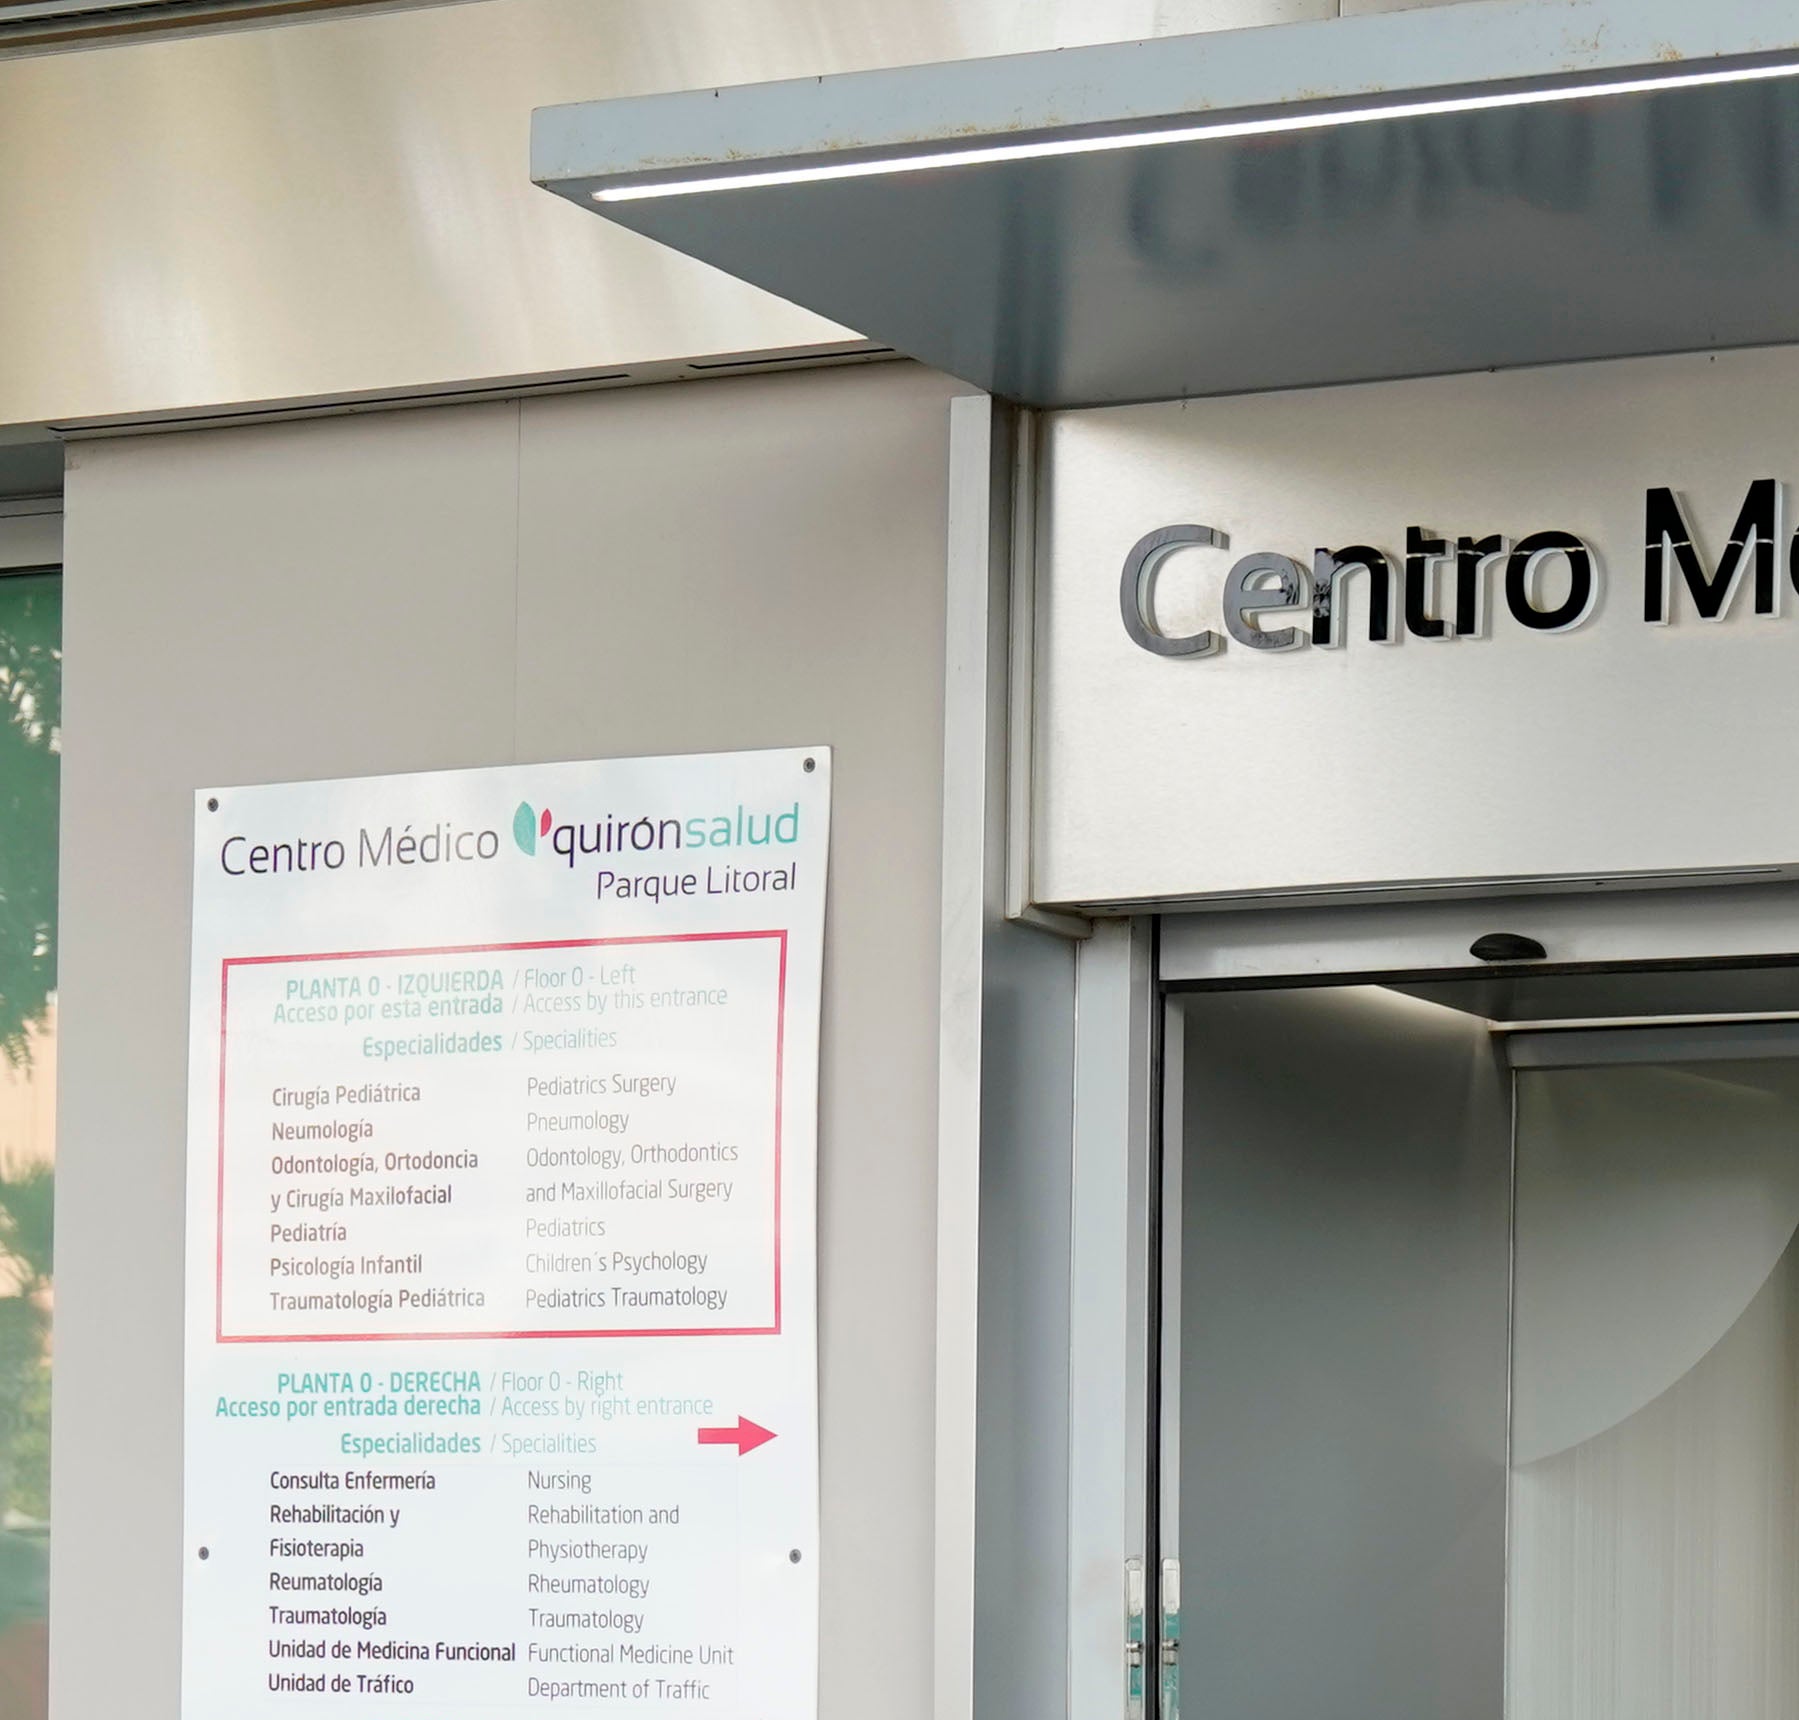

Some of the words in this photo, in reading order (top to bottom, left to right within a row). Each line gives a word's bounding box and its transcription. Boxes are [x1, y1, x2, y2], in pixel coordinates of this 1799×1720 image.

[1119, 522, 1605, 659] Centro
[222, 837, 344, 875] Centro
[360, 823, 498, 867] Médico
[553, 803, 798, 867] quirónsalud
[598, 871, 696, 904] Parque
[707, 862, 796, 894] Litoral
[287, 976, 361, 1000] PLANTA
[368, 976, 380, 996] 0
[398, 969, 504, 998] IZQUIERDA
[525, 968, 566, 988] Floor
[572, 966, 583, 987] 0
[601, 963, 636, 985] Left
[273, 1003, 338, 1024] Acceso
[344, 1004, 375, 1026] por
[381, 999, 421, 1019] esta
[428, 992, 503, 1016] entrada
[363, 1031, 502, 1062] Especialidades
[524, 1028, 616, 1054] Specialities
[273, 1086, 329, 1110] Cirugía
[336, 1083, 420, 1104] Pediátrica
[528, 1075, 606, 1096] Pediatrics
[612, 1074, 676, 1097] Surgery
[273, 1119, 373, 1143] Neumología
[528, 1110, 629, 1134] Pneumology
[272, 1152, 378, 1177] Odontología,
[385, 1149, 478, 1171] Ortodoncia
[527, 1146, 624, 1169] Odontology,
[631, 1142, 738, 1163] Orthodontics
[271, 1194, 281, 1213] y
[287, 1188, 343, 1212] Cirugía
[351, 1184, 451, 1206] Maxilofacial
[526, 1182, 556, 1202] and
[562, 1179, 662, 1200] Maxillofacial
[668, 1179, 733, 1202] Surgery
[271, 1222, 346, 1242] Pediatría
[271, 1256, 354, 1280] Psicología
[361, 1254, 422, 1274] Infantil
[613, 1251, 707, 1275] Psychology
[270, 1289, 392, 1313] Traumatología
[399, 1288, 484, 1308] Pediátrica
[527, 1288, 605, 1308] Pediatrics
[611, 1286, 727, 1310] Traumatology
[278, 1372, 354, 1394] PLANTA
[360, 1372, 372, 1393] 0
[390, 1371, 481, 1393] DERECHA
[502, 1372, 544, 1392] Floor
[549, 1371, 560, 1391] 0
[578, 1371, 623, 1398] Right
[216, 1397, 280, 1417] Acceso
[287, 1400, 318, 1421] por
[324, 1395, 397, 1416] entrada
[404, 1394, 480, 1416] derecha
[341, 1432, 481, 1458] Especialidades
[502, 1432, 596, 1458] Specialities
[271, 1471, 339, 1489] Consulta
[345, 1471, 435, 1489] Enfermería
[528, 1470, 591, 1494] Nursing
[271, 1504, 384, 1523] Rehabilitación
[390, 1509, 400, 1528] y
[529, 1504, 643, 1524] Rehabilitation
[649, 1505, 679, 1524] and
[270, 1538, 363, 1561] Fisioterapia
[529, 1539, 648, 1564] Physiotherapy
[270, 1572, 382, 1596] Reumatología
[529, 1574, 649, 1599] Rheumatology
[269, 1606, 386, 1630] Traumatología
[529, 1608, 644, 1633] Traumatology
[269, 1639, 325, 1658] Unidad
[331, 1640, 351, 1659] de
[358, 1641, 429, 1660] Medicina
[436, 1642, 515, 1661] Funcional
[529, 1643, 613, 1663] Functional
[620, 1644, 693, 1664] Medicine
[700, 1645, 734, 1664] Unit
[269, 1673, 325, 1692] Unidad
[331, 1674, 351, 1692] de
[357, 1675, 413, 1693] Tráfico
[528, 1677, 627, 1701] Department
[632, 1679, 650, 1699] of
[655, 1680, 709, 1699] Traffic
